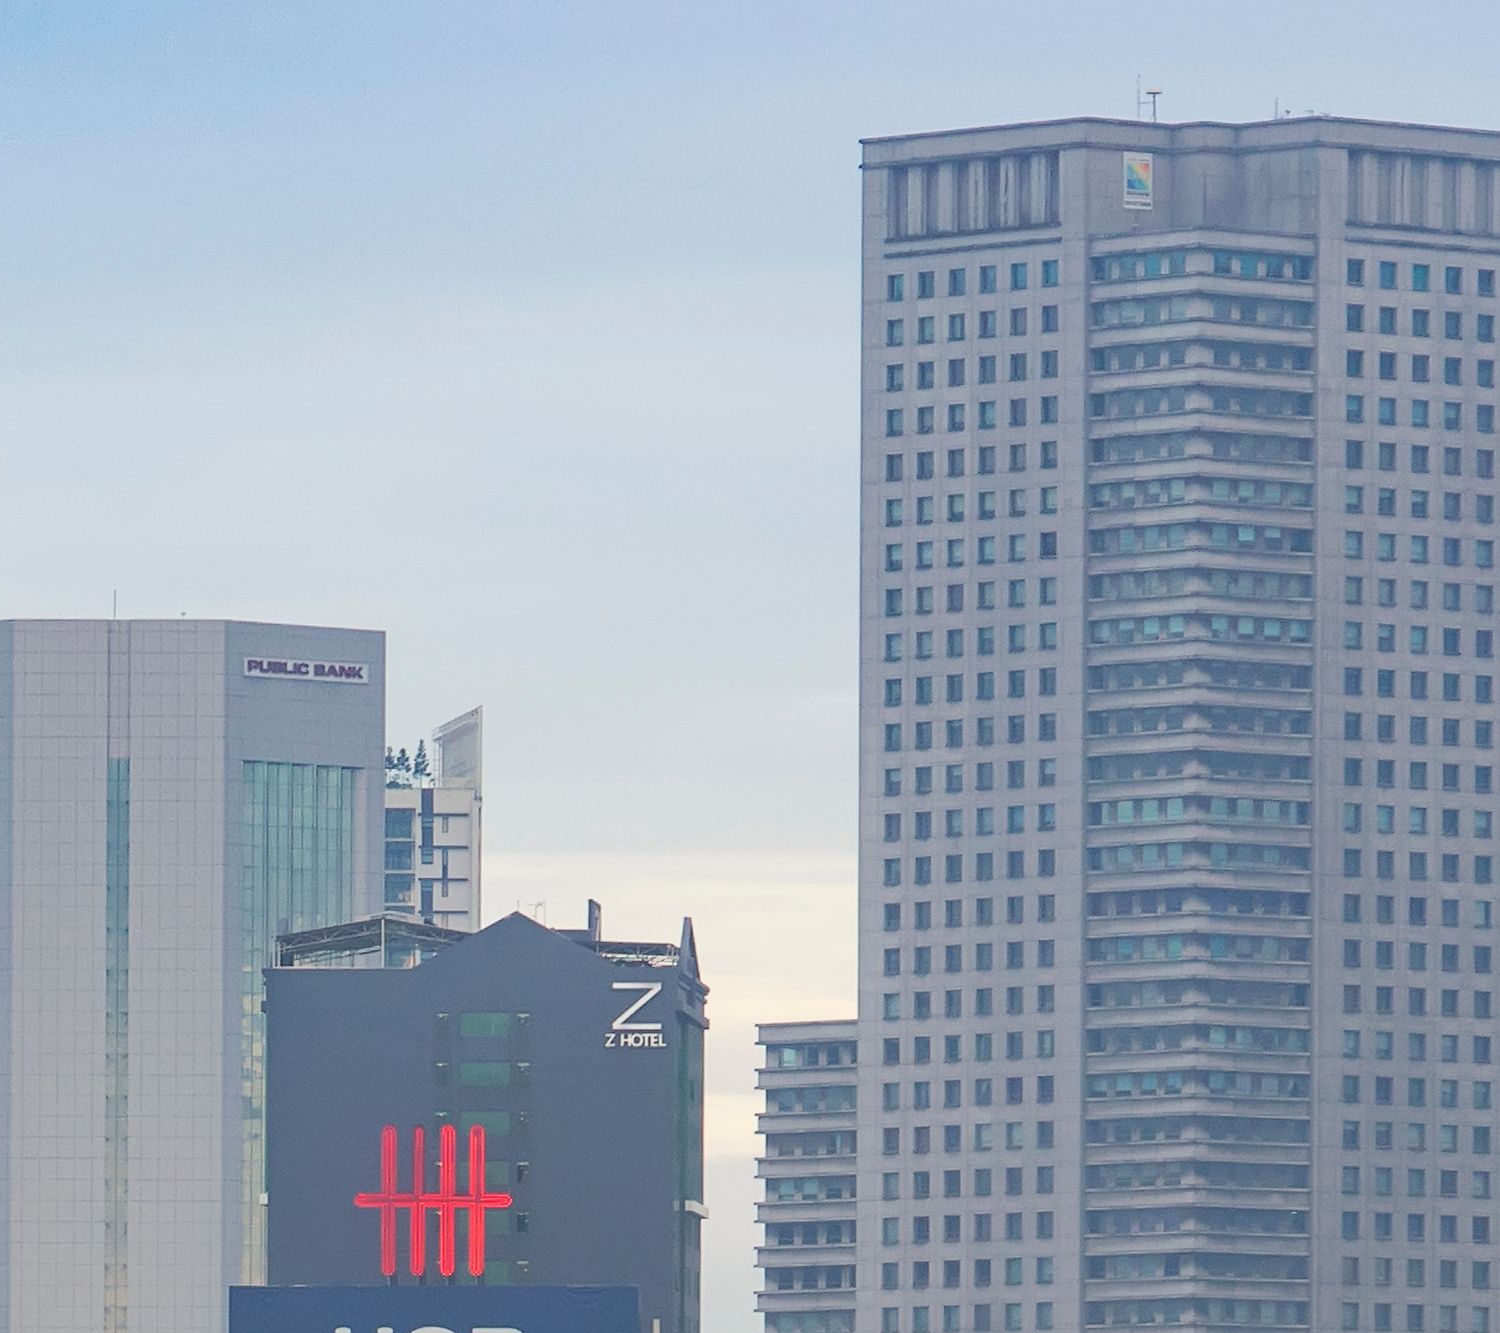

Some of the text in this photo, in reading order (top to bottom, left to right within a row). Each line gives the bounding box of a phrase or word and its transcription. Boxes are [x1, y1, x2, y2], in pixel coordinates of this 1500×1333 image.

[247, 659, 364, 679] PUBLIC BANK
[605, 1033, 667, 1047] Z HOTEL
